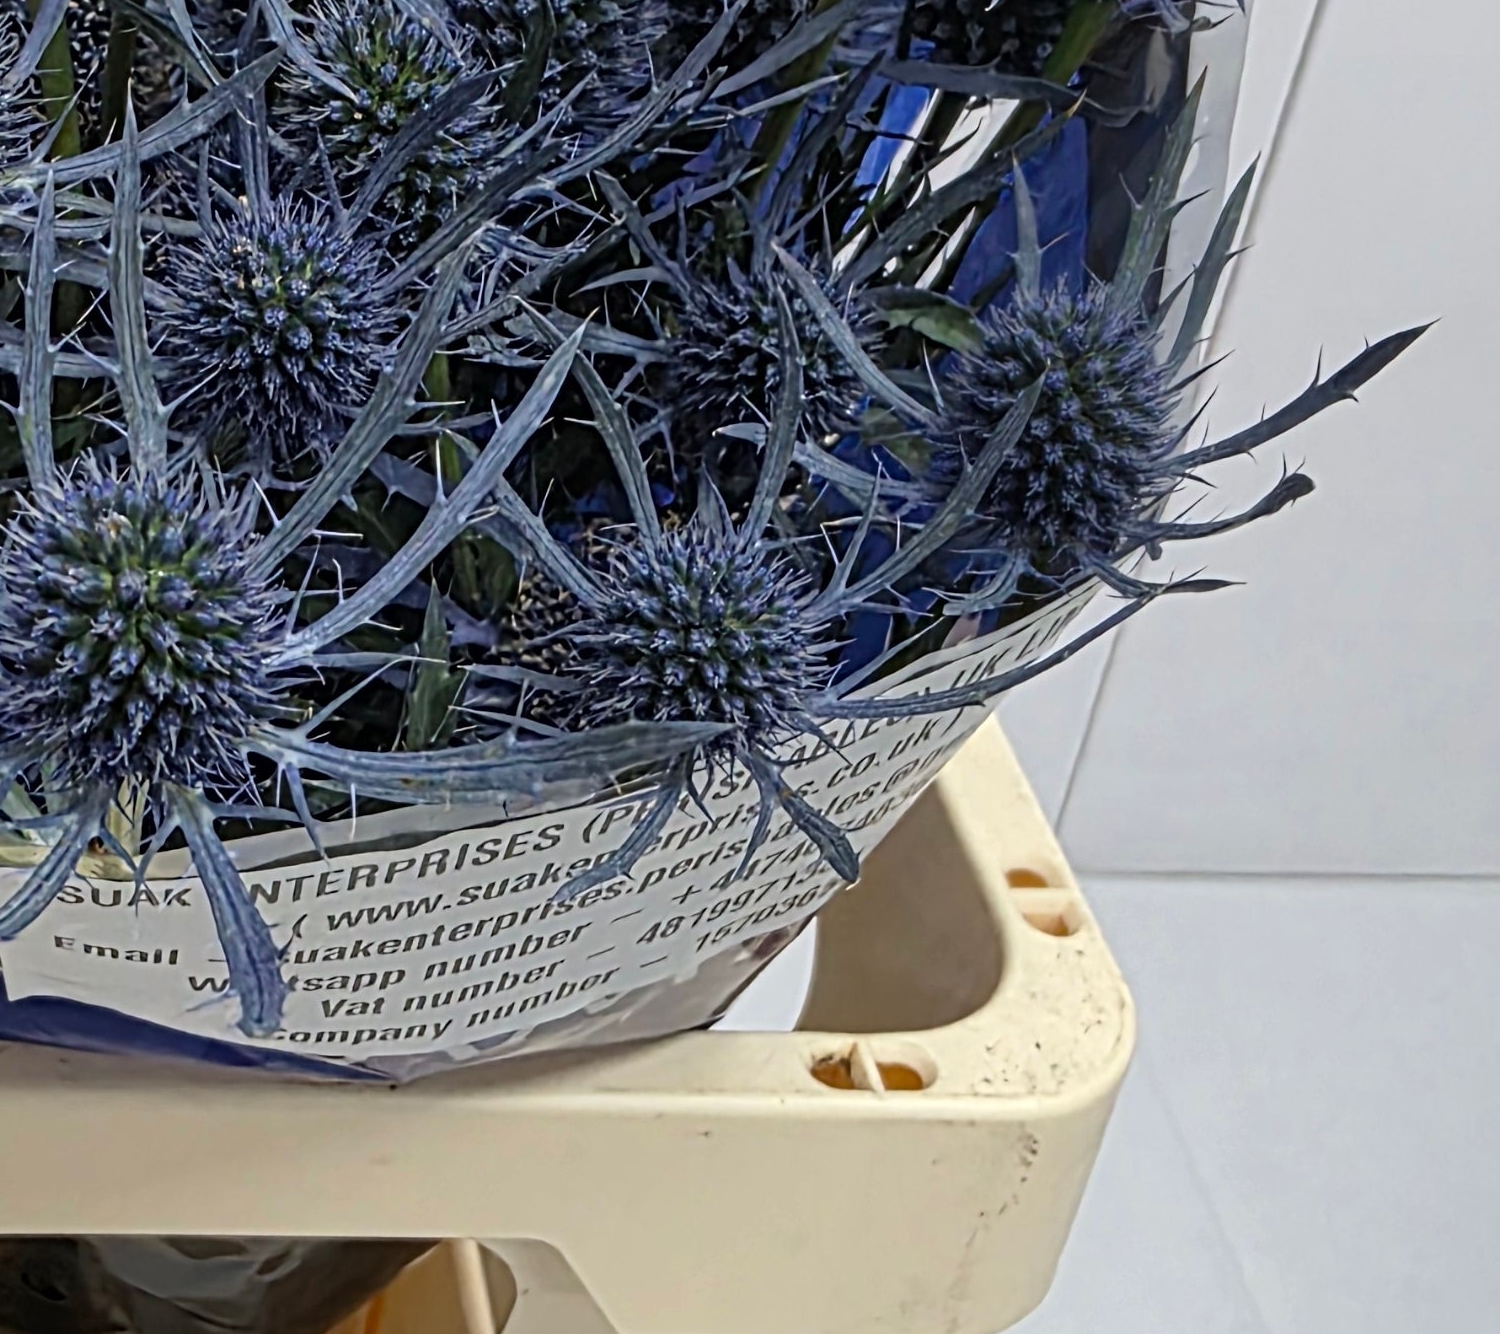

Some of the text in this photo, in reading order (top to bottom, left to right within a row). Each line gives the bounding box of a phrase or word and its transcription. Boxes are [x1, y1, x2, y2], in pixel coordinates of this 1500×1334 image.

[55, 883, 192, 908] SUAK
[249, 823, 565, 905] NTERPRISES
[54, 934, 179, 965] Email
[424, 921, 594, 981] number
[321, 996, 386, 1018] Vat
[402, 959, 566, 1013] number
[466, 967, 621, 1029] number
